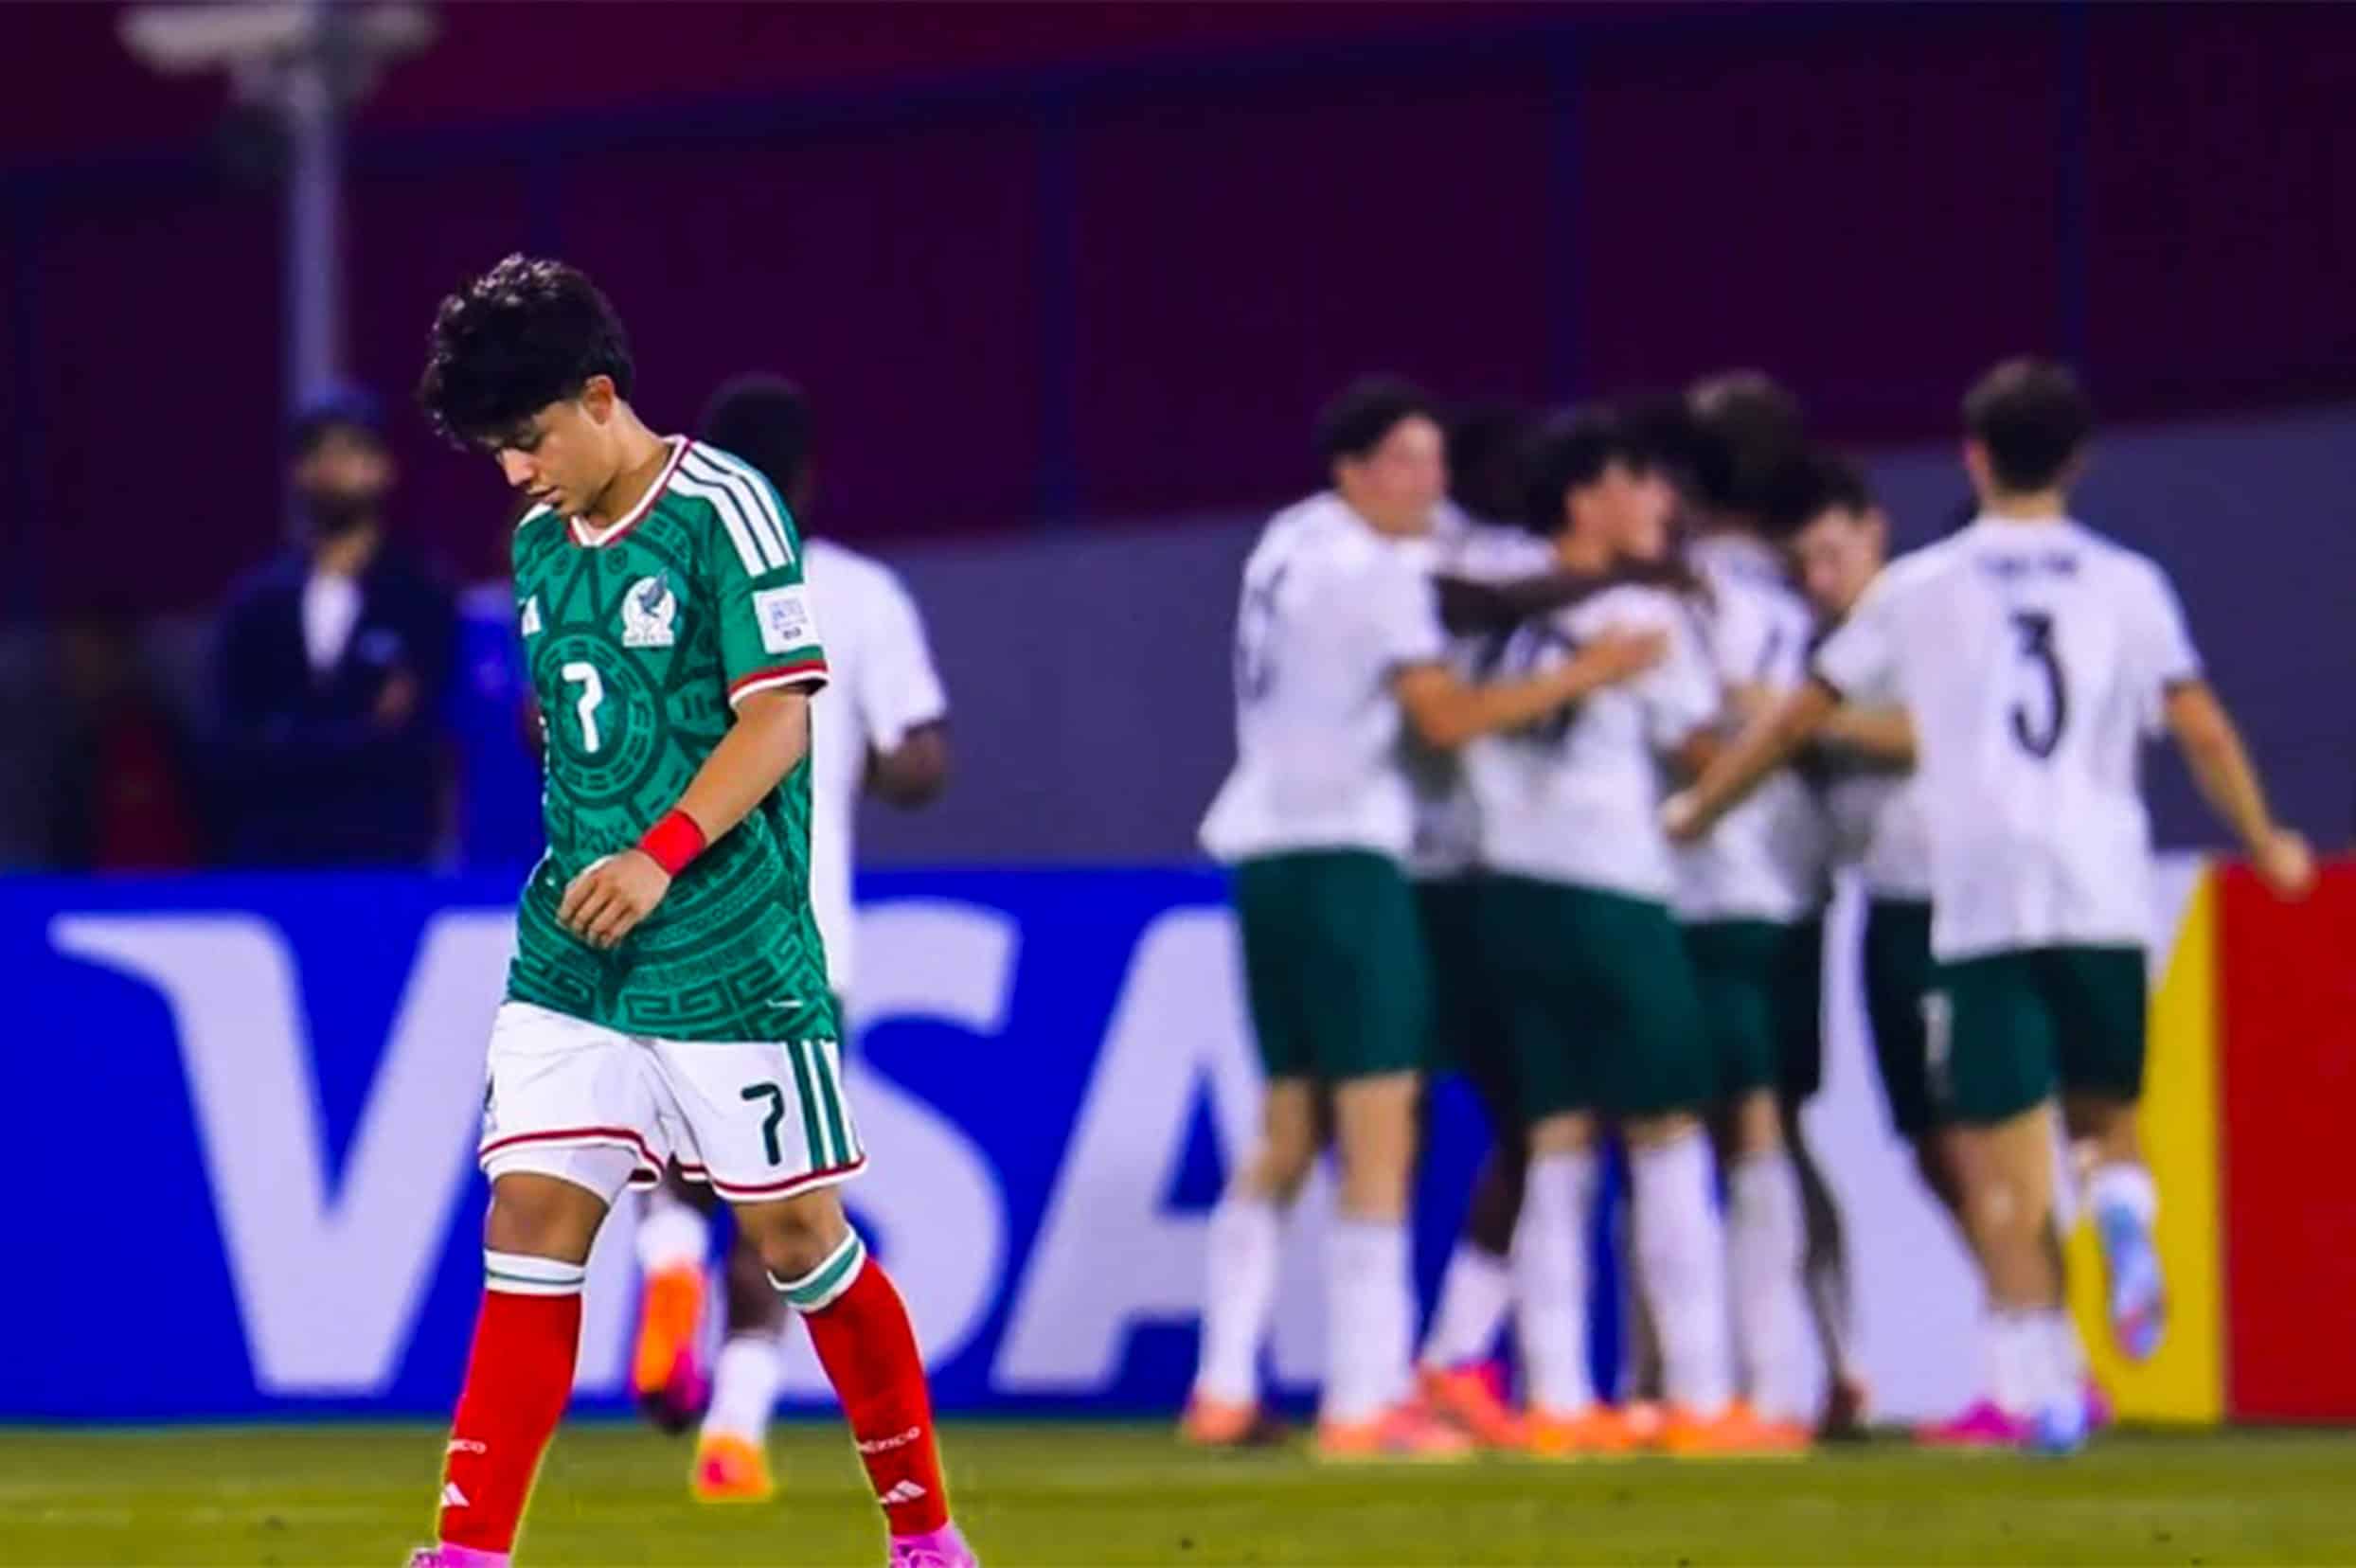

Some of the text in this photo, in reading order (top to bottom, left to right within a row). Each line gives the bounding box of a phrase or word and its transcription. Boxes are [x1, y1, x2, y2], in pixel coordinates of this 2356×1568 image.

[562, 662, 604, 753] 7
[2010, 610, 2067, 761] 3
[47, 895, 1328, 1399] VSA
[741, 1081, 785, 1166] 7
